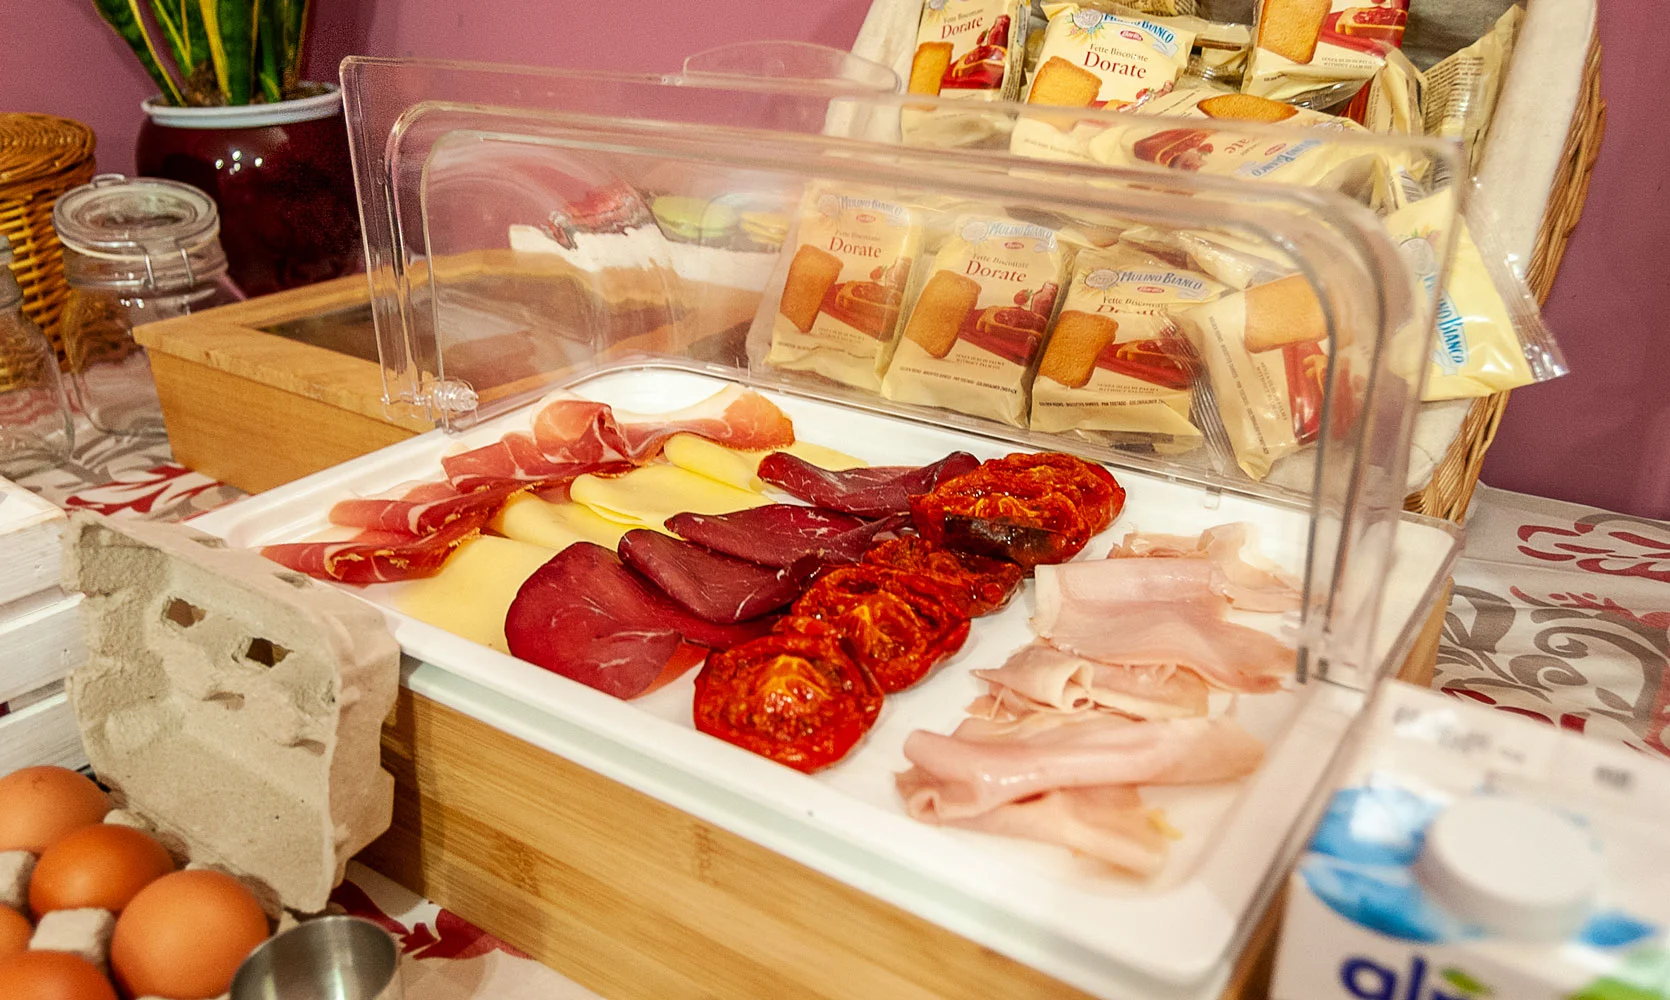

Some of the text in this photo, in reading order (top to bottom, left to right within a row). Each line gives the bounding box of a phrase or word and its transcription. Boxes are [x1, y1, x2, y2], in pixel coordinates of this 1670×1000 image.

[941, 17, 983, 39] Dorate
[1090, 43, 1109, 55] Fette
[1084, 51, 1147, 79] Dorate
[829, 236, 881, 258] Dorate
[966, 259, 1026, 282] Dorate
[1119, 271, 1203, 290] MULINO BIANCO
[1437, 316, 1465, 364] BIANCO
